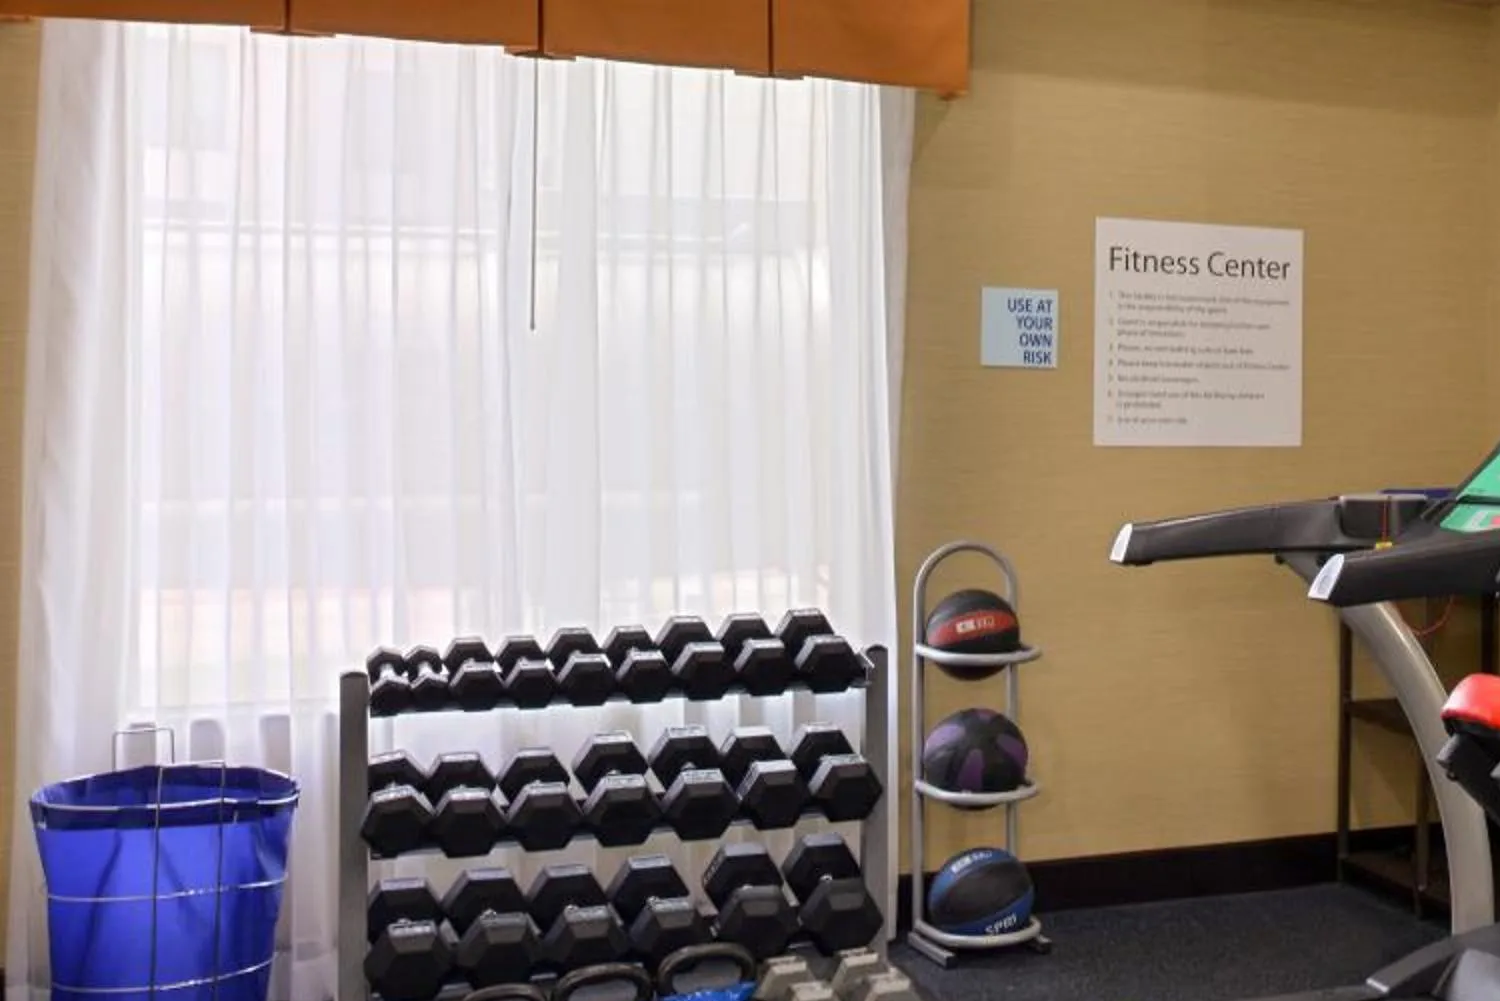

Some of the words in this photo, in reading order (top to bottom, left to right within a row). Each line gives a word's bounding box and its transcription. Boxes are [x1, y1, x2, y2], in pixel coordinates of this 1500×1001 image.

[1109, 246, 1200, 275] Fitness
[1207, 251, 1290, 280] Center
[1007, 298, 1033, 313] USE
[1036, 299, 1053, 313] AT
[1016, 315, 1053, 330] YOUR
[1019, 333, 1052, 347] OWN
[1023, 350, 1052, 365] RISK
